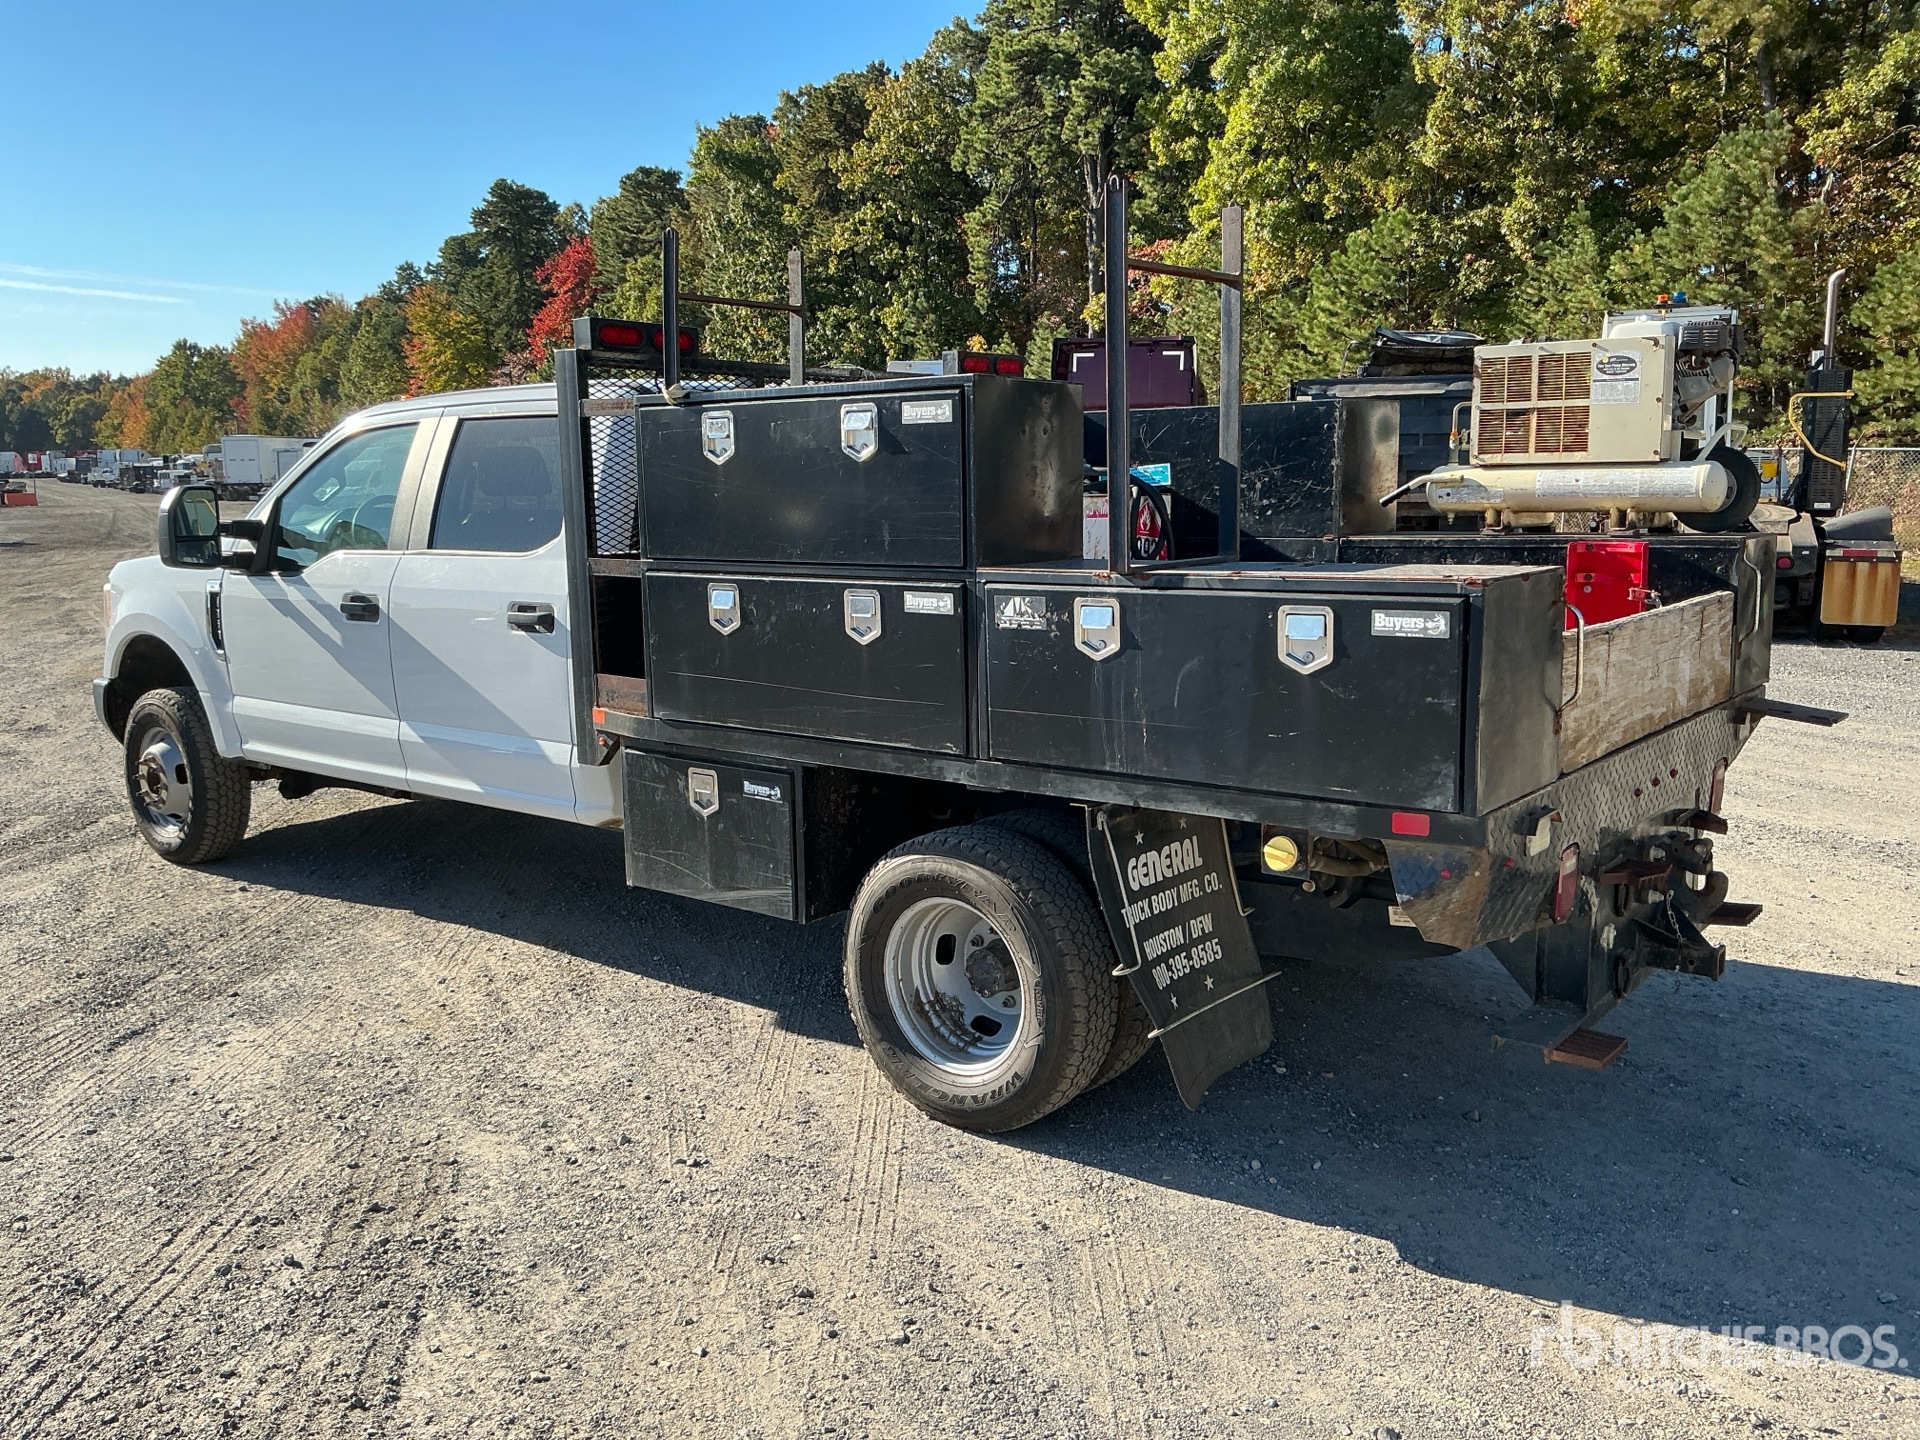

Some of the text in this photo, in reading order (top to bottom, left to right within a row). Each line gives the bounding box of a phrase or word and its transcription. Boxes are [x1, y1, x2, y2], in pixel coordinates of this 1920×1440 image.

[903, 405, 936, 419] Buyers
[905, 594, 938, 609] Buyers
[1374, 612, 1425, 631] Buyers
[744, 781, 770, 794] Buyers
[1127, 835, 1203, 891] GENERAL
[872, 872, 1017, 933] GOODYEAR
[1121, 872, 1223, 928] TRUCK BODY MFG. CO.
[1143, 925, 1185, 961] HOUSTON
[1190, 913, 1214, 939] DFW
[1152, 938, 1223, 991] 800-395-8585
